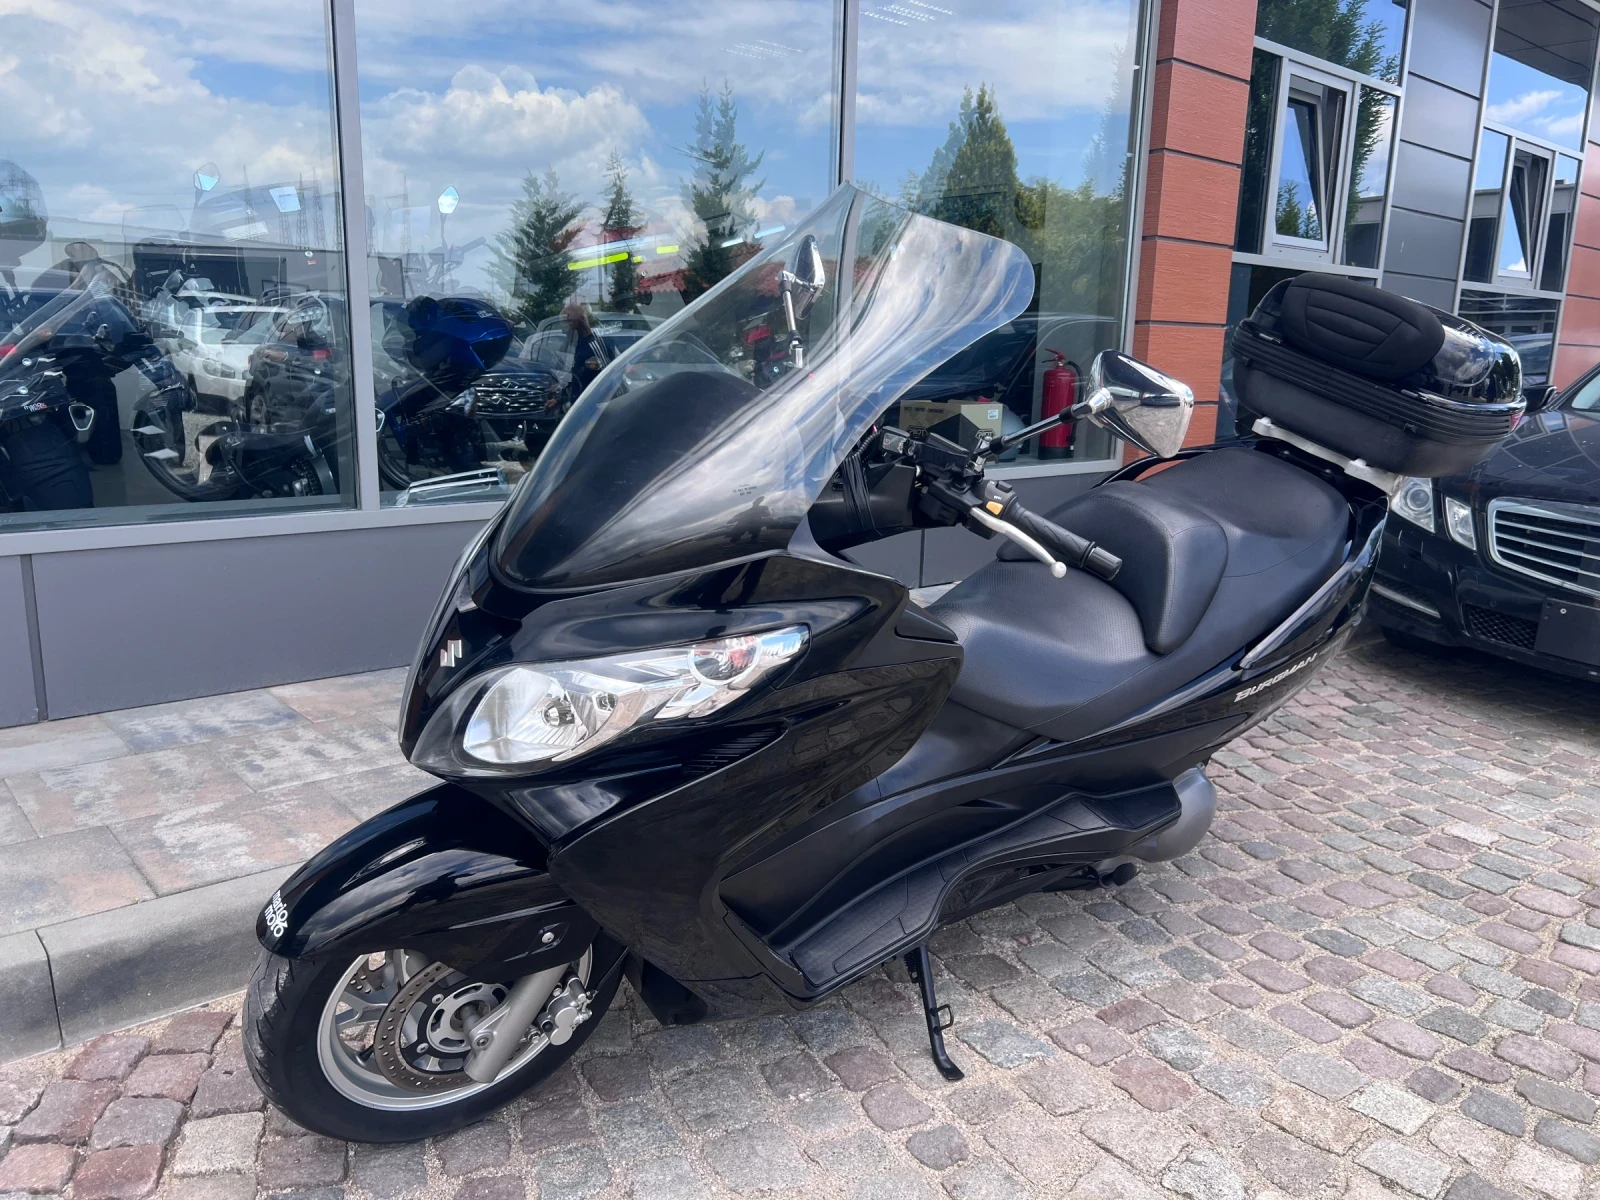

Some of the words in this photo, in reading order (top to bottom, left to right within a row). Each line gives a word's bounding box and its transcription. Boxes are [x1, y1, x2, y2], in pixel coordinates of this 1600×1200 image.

[1233, 652, 1317, 702] BURGMAN
[264, 904, 288, 938] moto
[272, 889, 288, 921] mario
